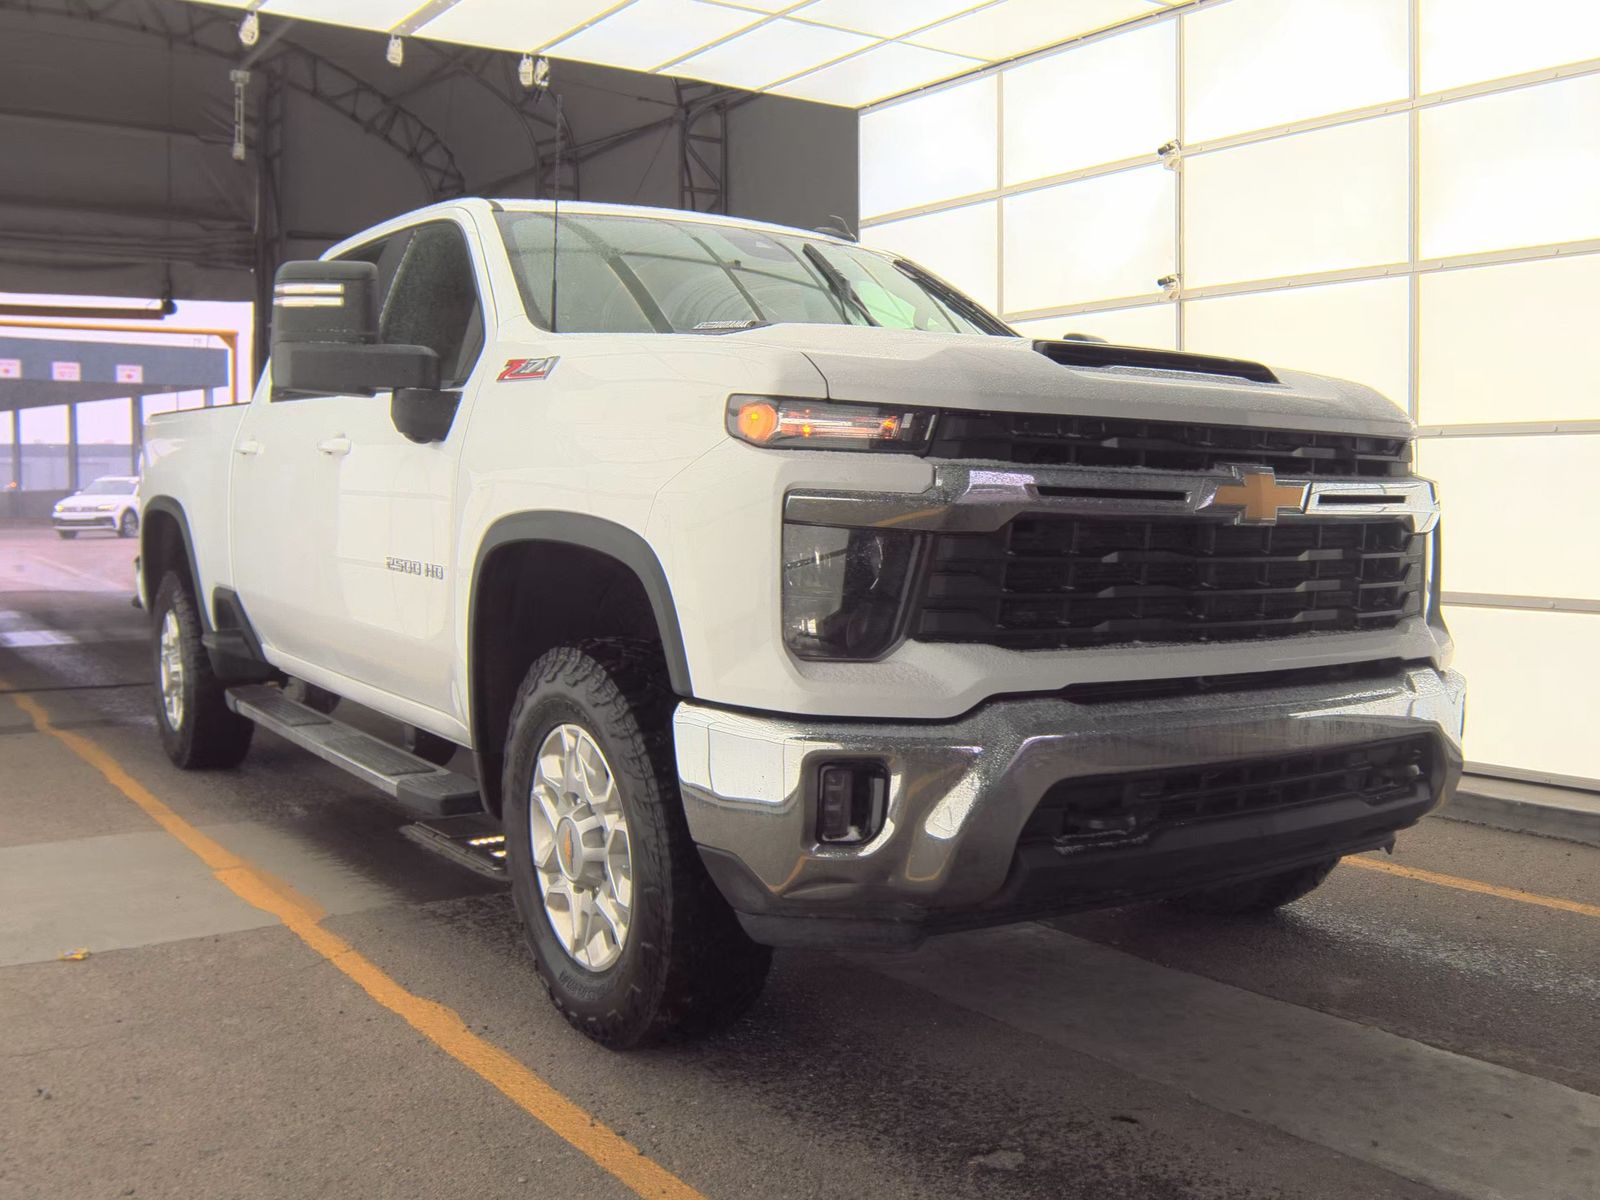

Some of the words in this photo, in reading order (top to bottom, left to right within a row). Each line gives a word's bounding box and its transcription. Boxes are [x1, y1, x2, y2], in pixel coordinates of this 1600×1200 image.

[496, 355, 560, 382] Z71
[386, 556, 421, 576] 2500
[425, 562, 444, 580] HD
